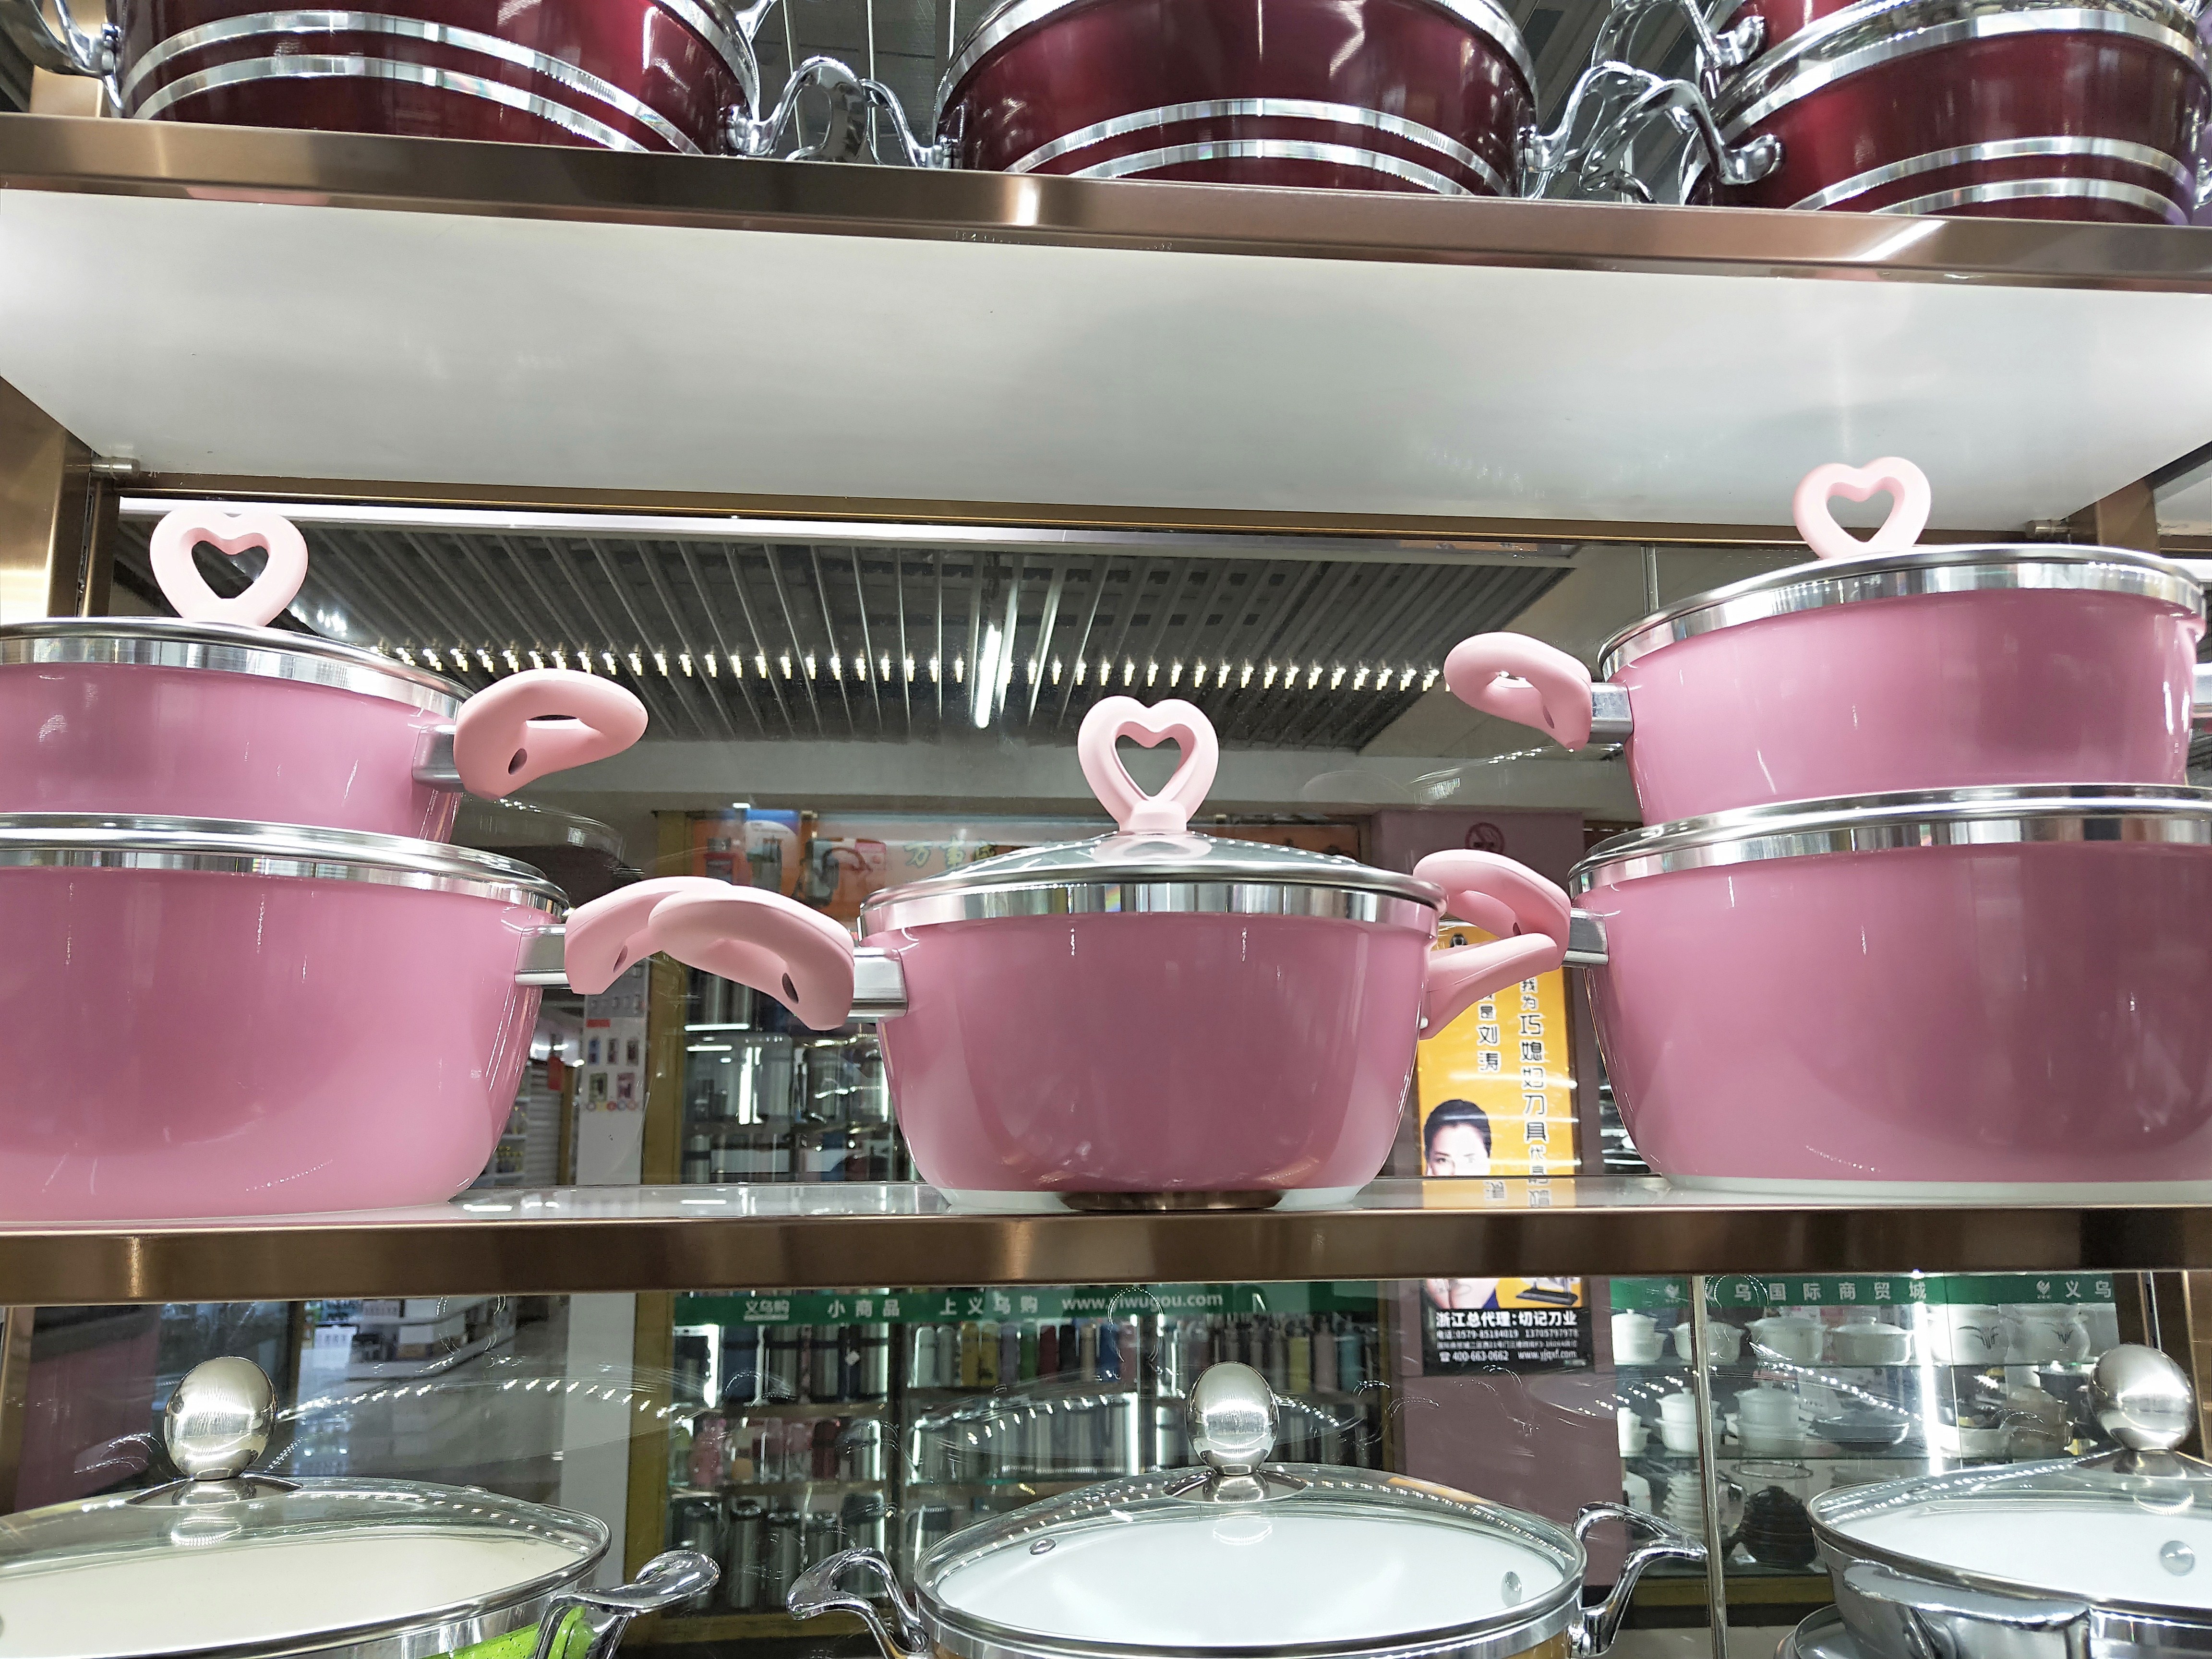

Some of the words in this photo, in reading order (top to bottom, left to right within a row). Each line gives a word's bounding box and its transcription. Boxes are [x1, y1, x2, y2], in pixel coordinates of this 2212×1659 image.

[1477, 994, 1501, 1072] 是刘涛
[2065, 1280, 2112, 1298] 义乌
[828, 1298, 900, 1318] 小商品
